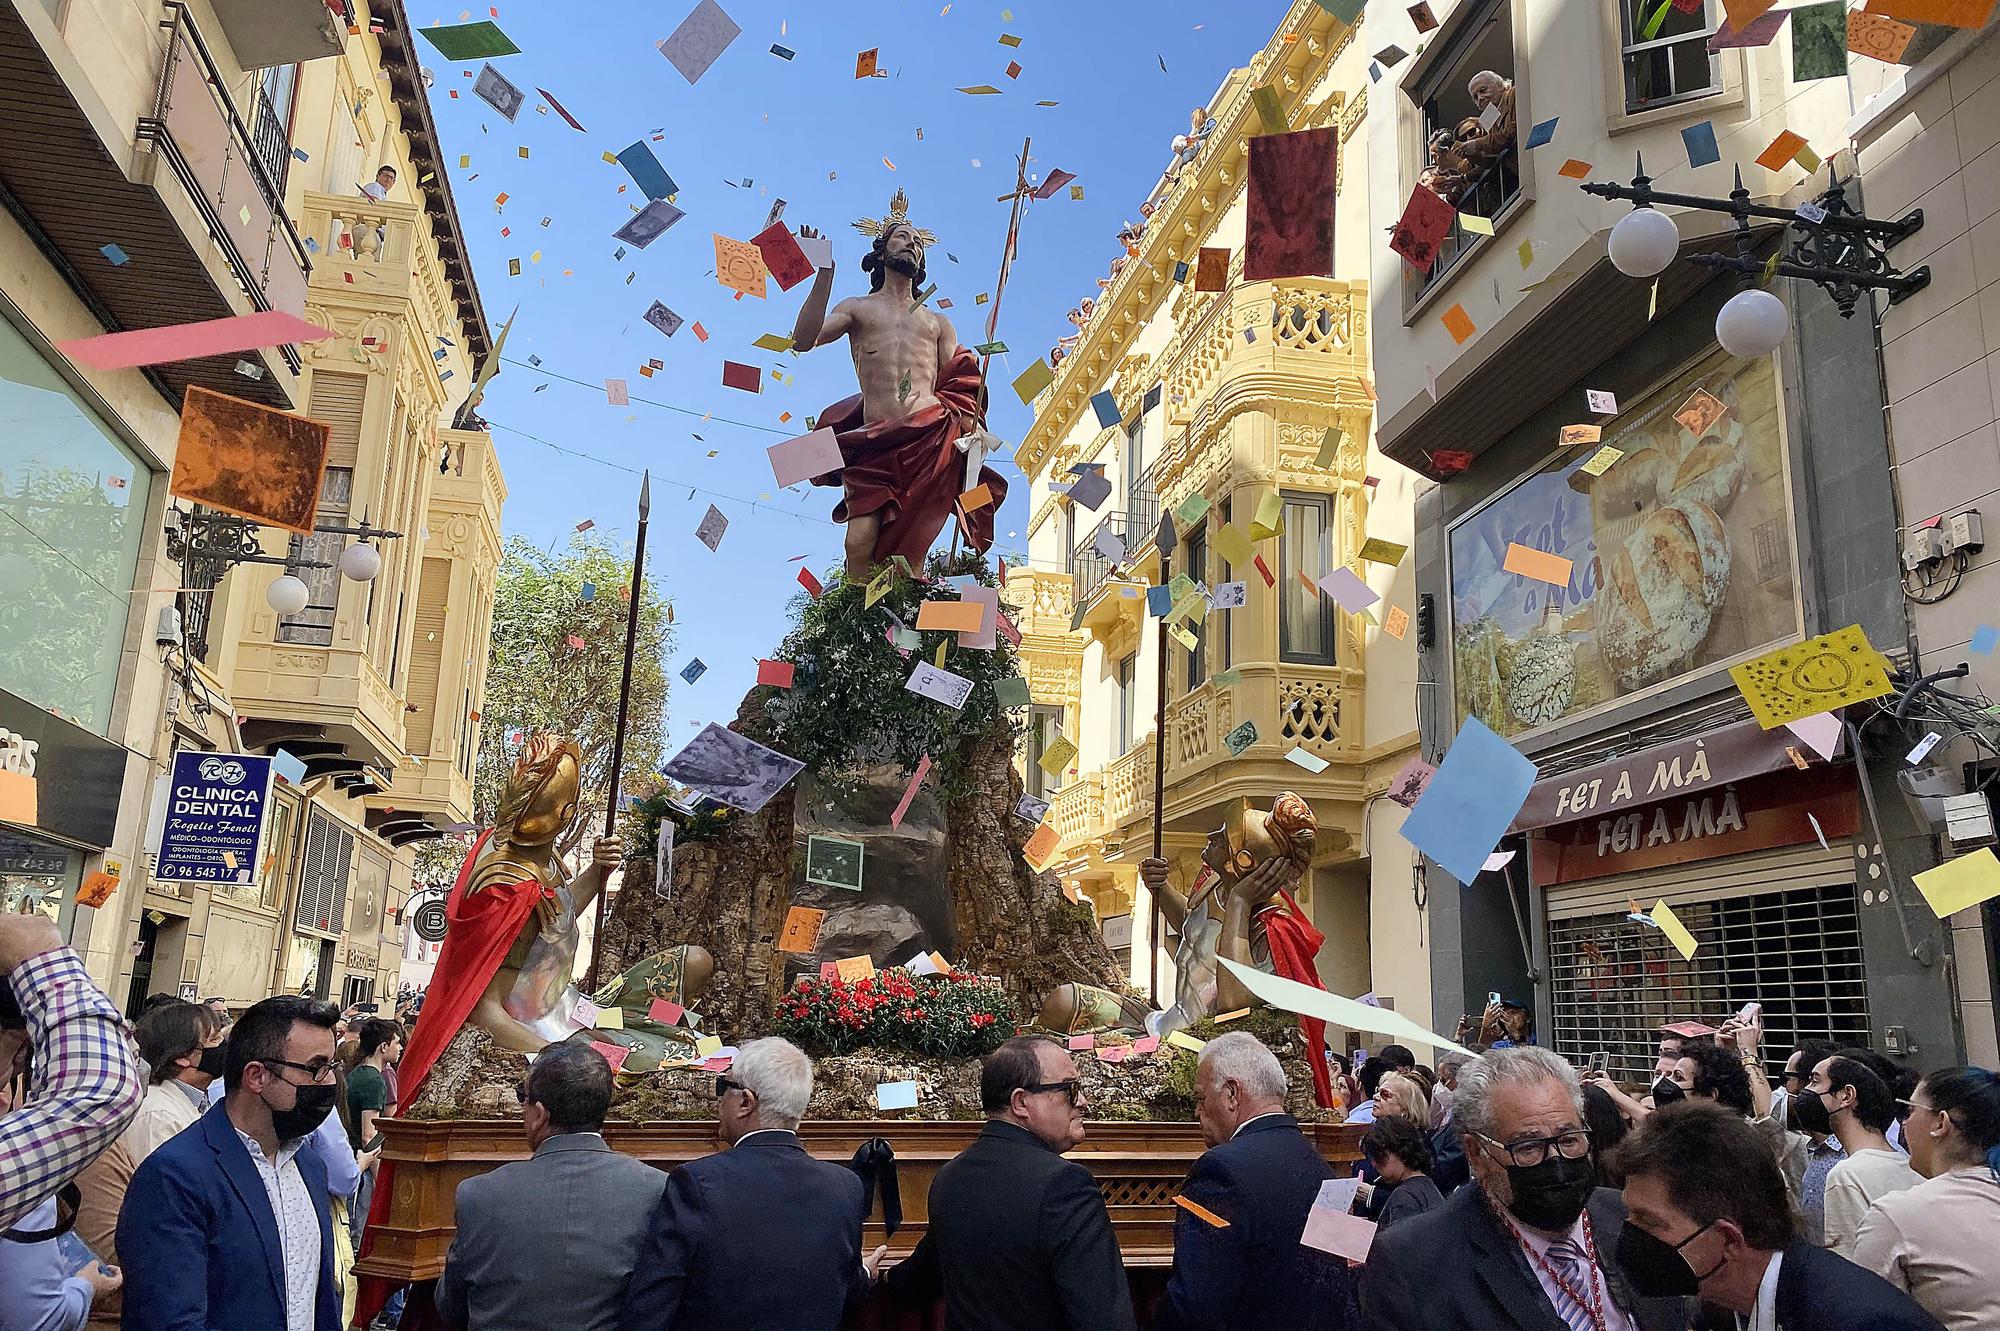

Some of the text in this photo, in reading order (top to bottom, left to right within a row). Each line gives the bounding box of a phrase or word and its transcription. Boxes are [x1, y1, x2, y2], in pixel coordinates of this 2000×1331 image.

[1556, 739, 1712, 817] FET A MÀ
[176, 786, 259, 802] CLINICA
[174, 801, 256, 818] DENTAL
[169, 819, 257, 833] Rogelio Fenoll
[1598, 784, 1745, 857] FET A MÀ
[179, 867, 192, 877] 96
[195, 867, 216, 878] 545
[220, 869, 233, 878] 17
[427, 911, 447, 929] B
